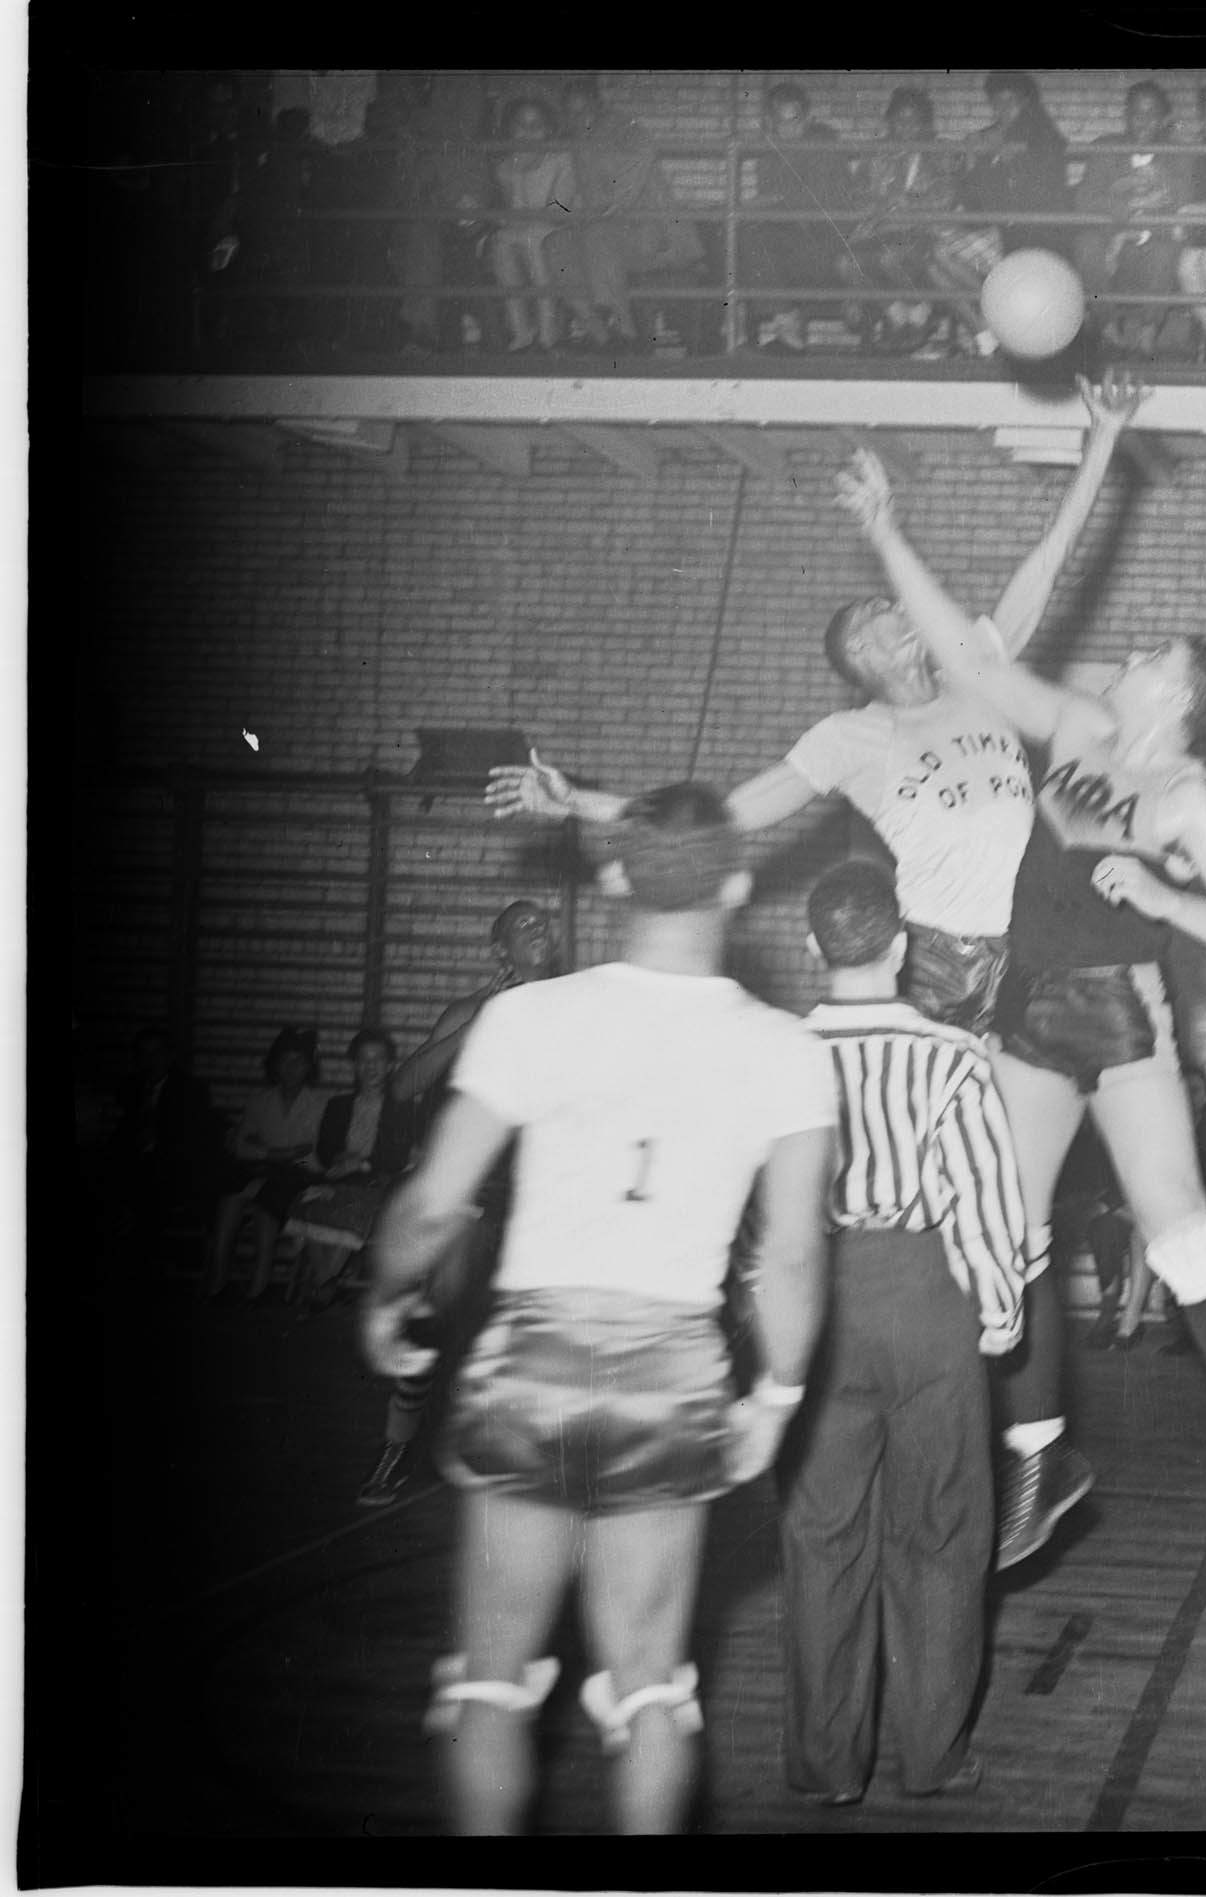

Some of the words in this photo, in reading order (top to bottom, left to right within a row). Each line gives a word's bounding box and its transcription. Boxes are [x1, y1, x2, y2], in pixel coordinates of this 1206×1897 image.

[897, 750, 943, 800] OLD
[952, 732, 1030, 771] TIMER
[938, 782, 969, 808] OF
